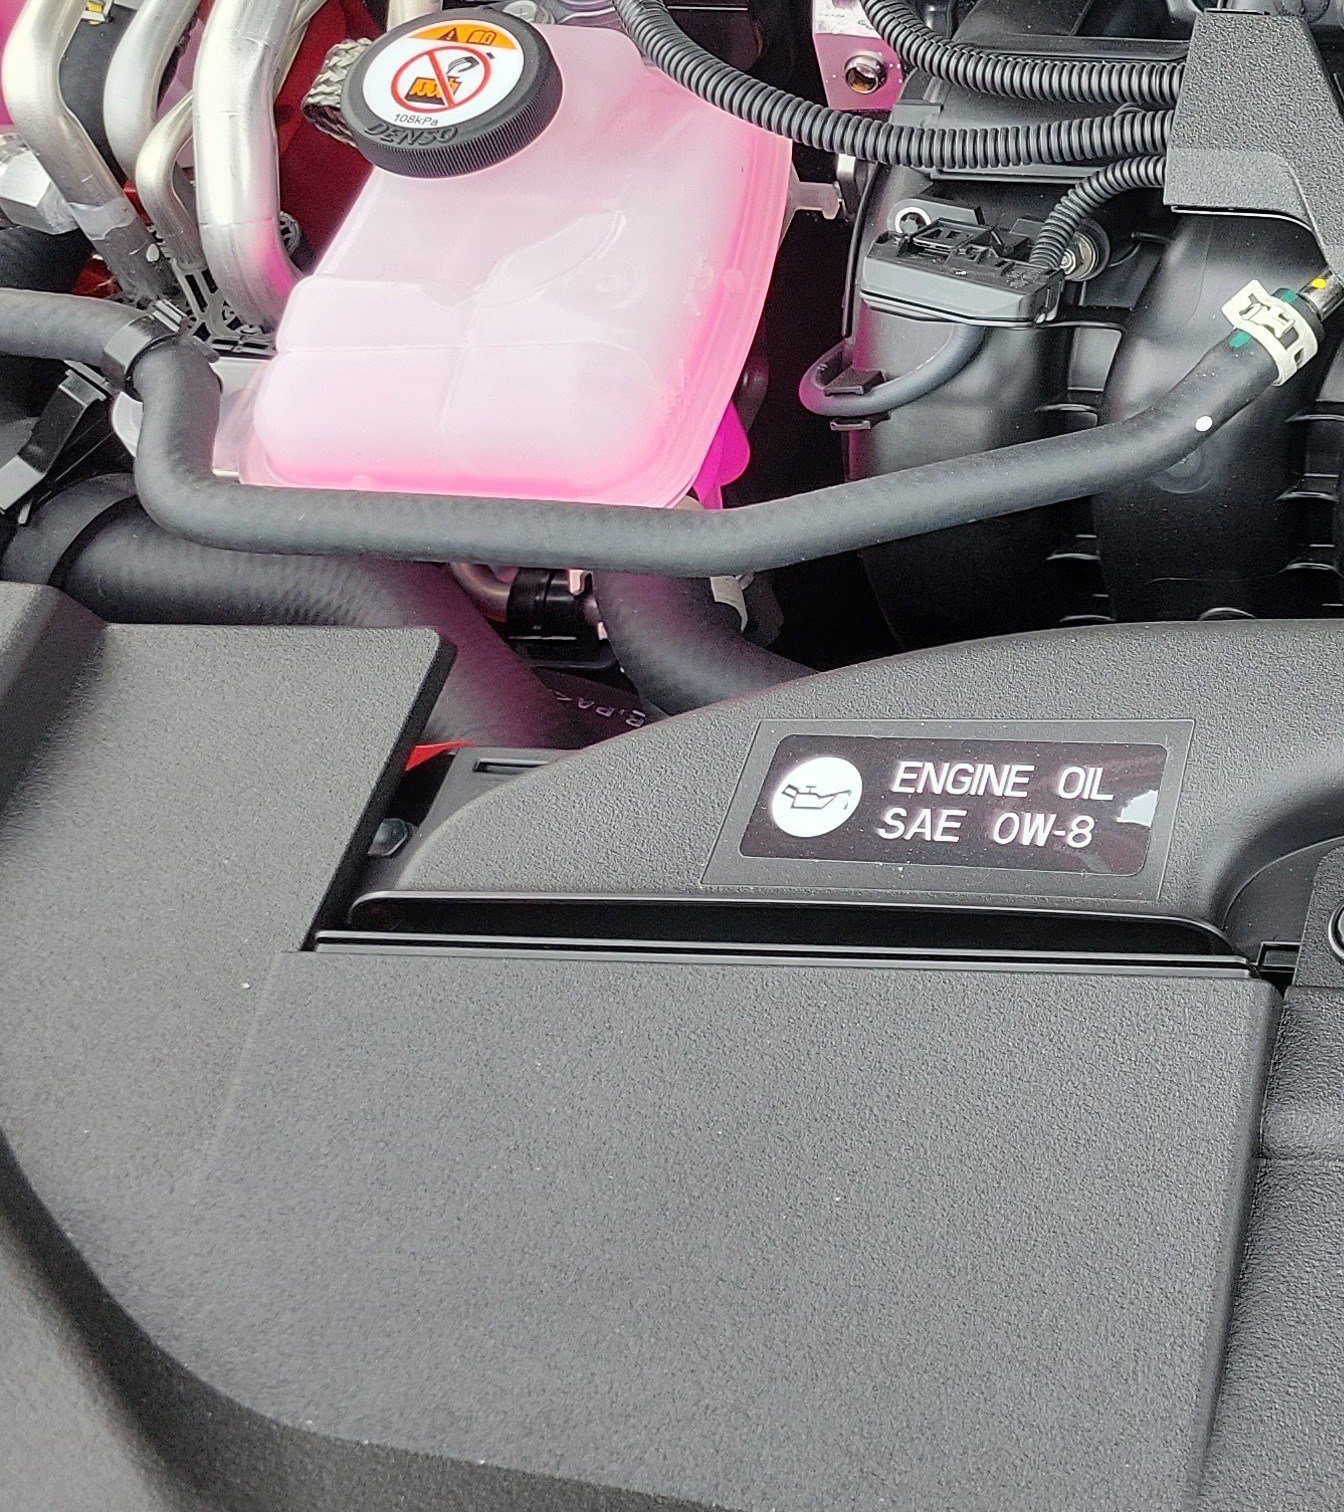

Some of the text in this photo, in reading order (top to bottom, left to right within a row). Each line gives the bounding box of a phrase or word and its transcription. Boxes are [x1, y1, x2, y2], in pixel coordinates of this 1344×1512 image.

[363, 122, 459, 146] DENSO
[394, 112, 439, 127] 108kPa
[892, 761, 1115, 802] ENGINE OIL
[877, 807, 969, 843] SAE
